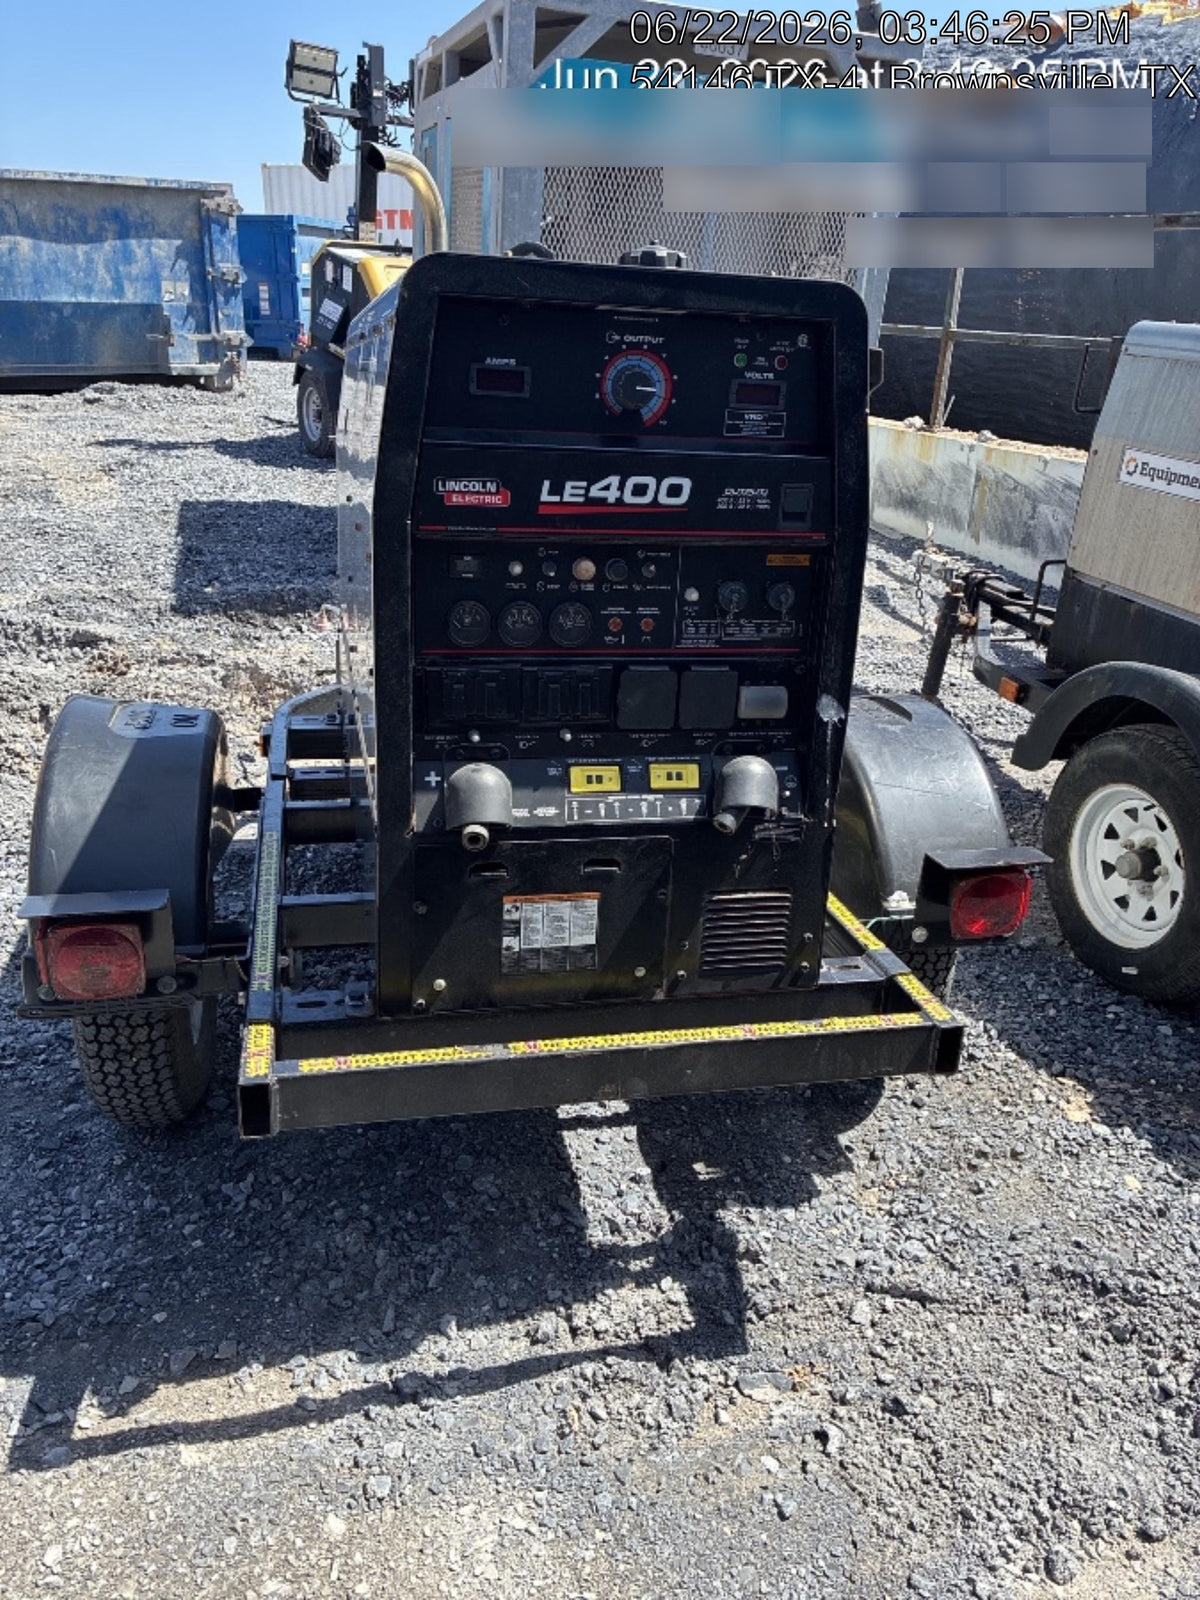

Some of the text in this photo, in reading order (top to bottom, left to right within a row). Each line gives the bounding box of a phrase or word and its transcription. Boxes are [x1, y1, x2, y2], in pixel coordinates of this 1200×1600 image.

[483, 356, 518, 367] AMPS
[1138, 461, 1200, 488] Equipme
[437, 479, 498, 494] LINCOLN
[539, 474, 693, 507] LE400
[451, 493, 503, 505] ELECTRIC
